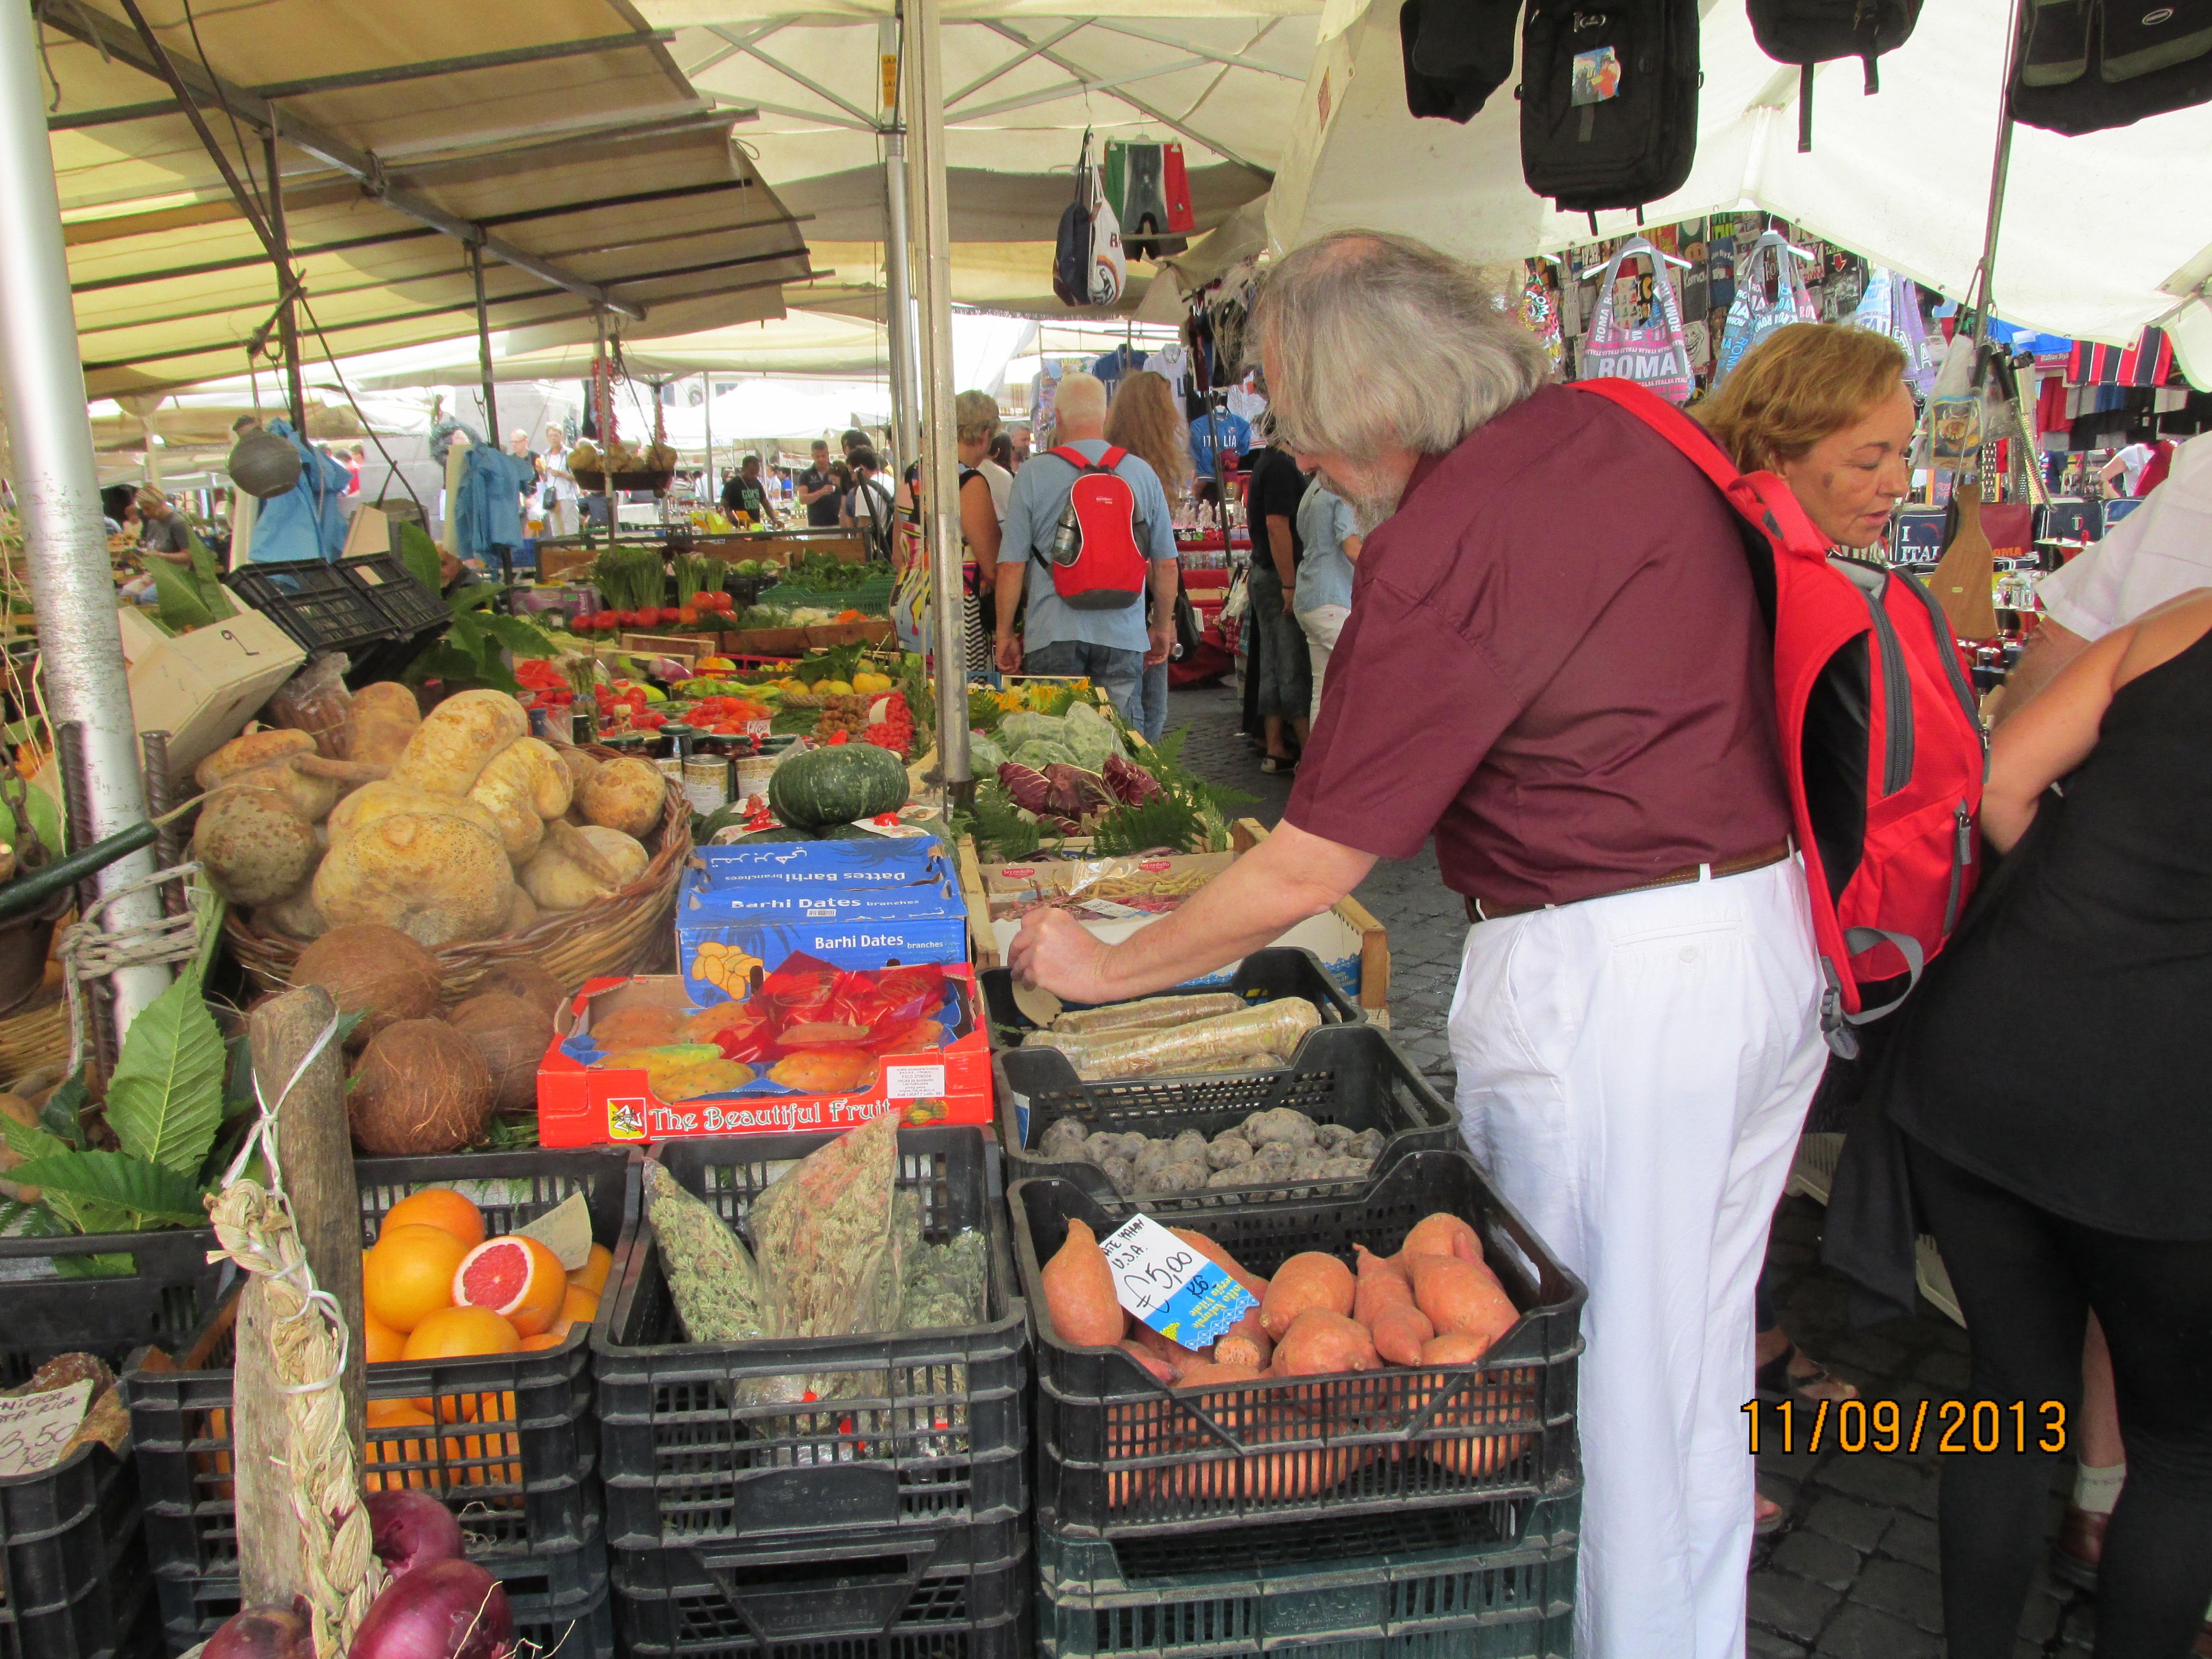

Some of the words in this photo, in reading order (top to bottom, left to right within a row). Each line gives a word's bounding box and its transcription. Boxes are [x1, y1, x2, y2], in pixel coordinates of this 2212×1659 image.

[1598, 352, 1678, 380] ROMA
[785, 872, 838, 882] Barhi
[843, 872, 905, 881] Dattes
[731, 899, 791, 909] Barhi
[799, 897, 861, 908] Dates
[815, 935, 856, 950] Barhi
[861, 935, 904, 948] Dates
[907, 941, 944, 949] branches
[648, 1107, 698, 1132] The
[703, 1102, 821, 1131] Beautiful
[829, 1098, 891, 1124] Fruit
